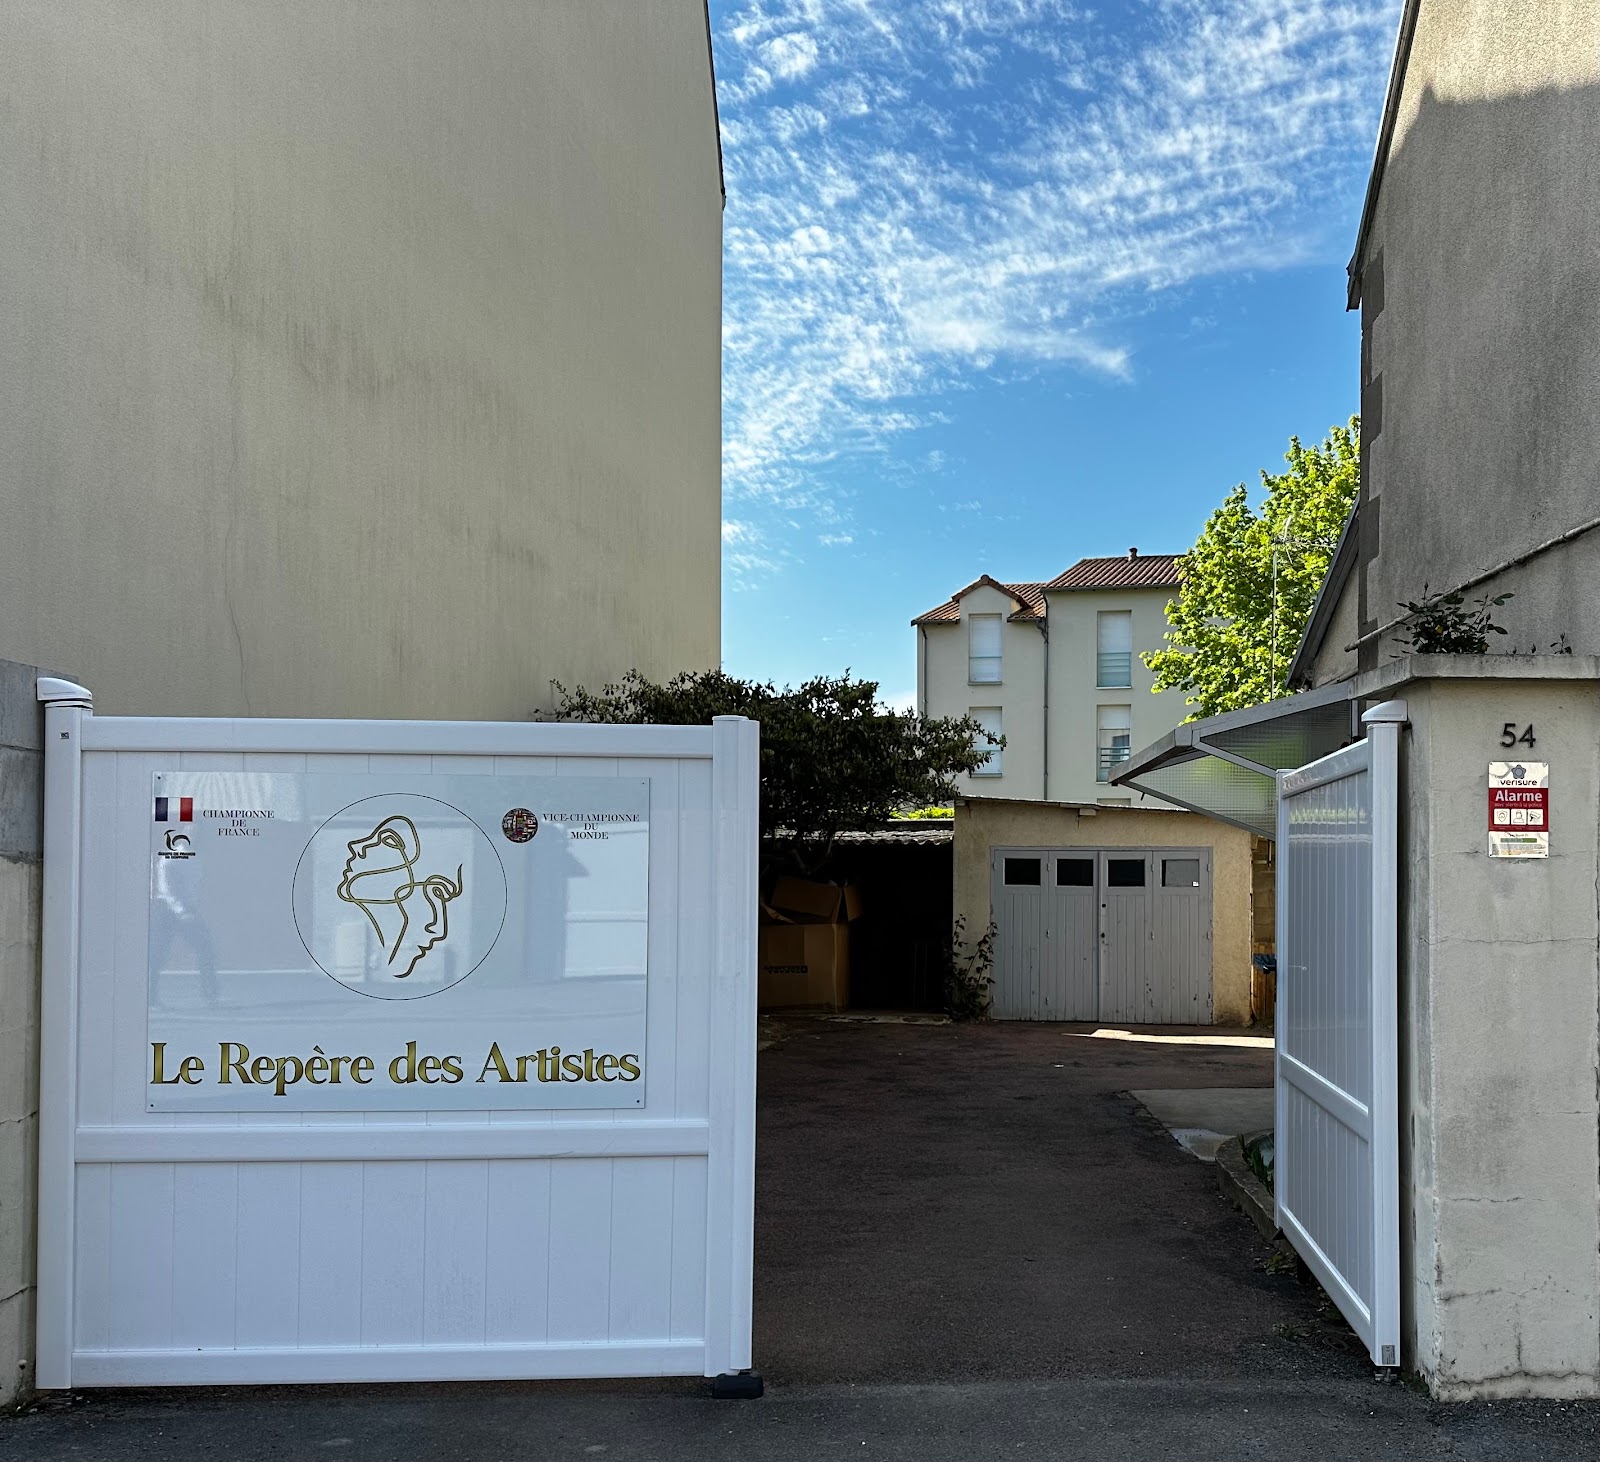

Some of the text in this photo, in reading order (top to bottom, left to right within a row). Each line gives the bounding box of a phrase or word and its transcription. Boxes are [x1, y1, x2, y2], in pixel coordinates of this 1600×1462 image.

[1500, 723, 1536, 748] 54
[1495, 790, 1543, 802] Alarme
[203, 810, 274, 818] CHAMPIONNE
[543, 814, 639, 822] VICE-CHAMPIONNE
[218, 828, 259, 836] FRANCE
[151, 1041, 641, 1096] Le Repère des Artistes
